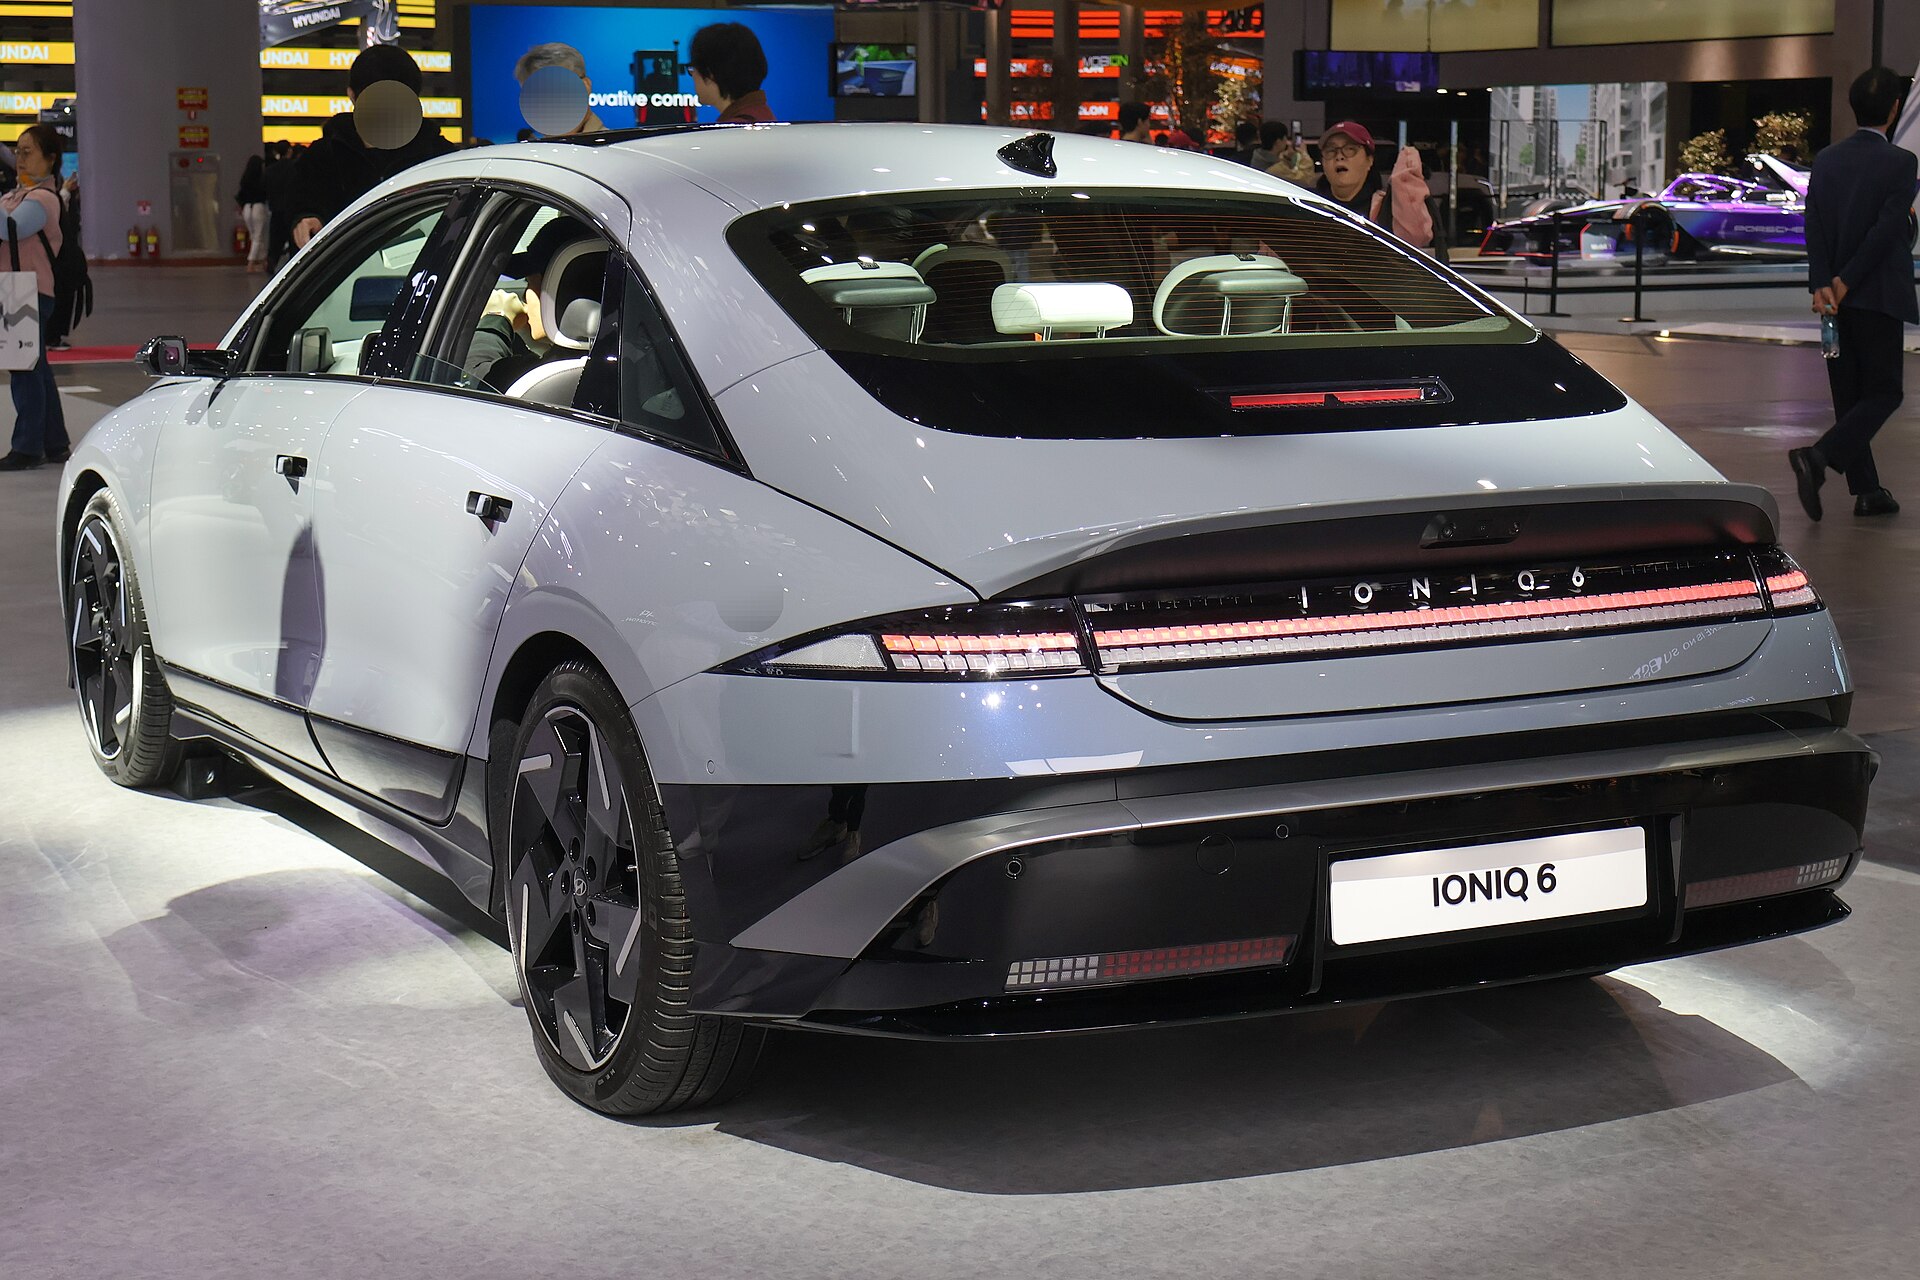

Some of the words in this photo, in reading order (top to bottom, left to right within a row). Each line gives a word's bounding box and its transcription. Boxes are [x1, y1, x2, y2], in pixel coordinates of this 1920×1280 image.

[292, 7, 341, 29] HYUNDAI
[1734, 224, 1805, 234] PORSCHE
[1432, 866, 1529, 908] IONIQ
[1537, 862, 1557, 894] 6
